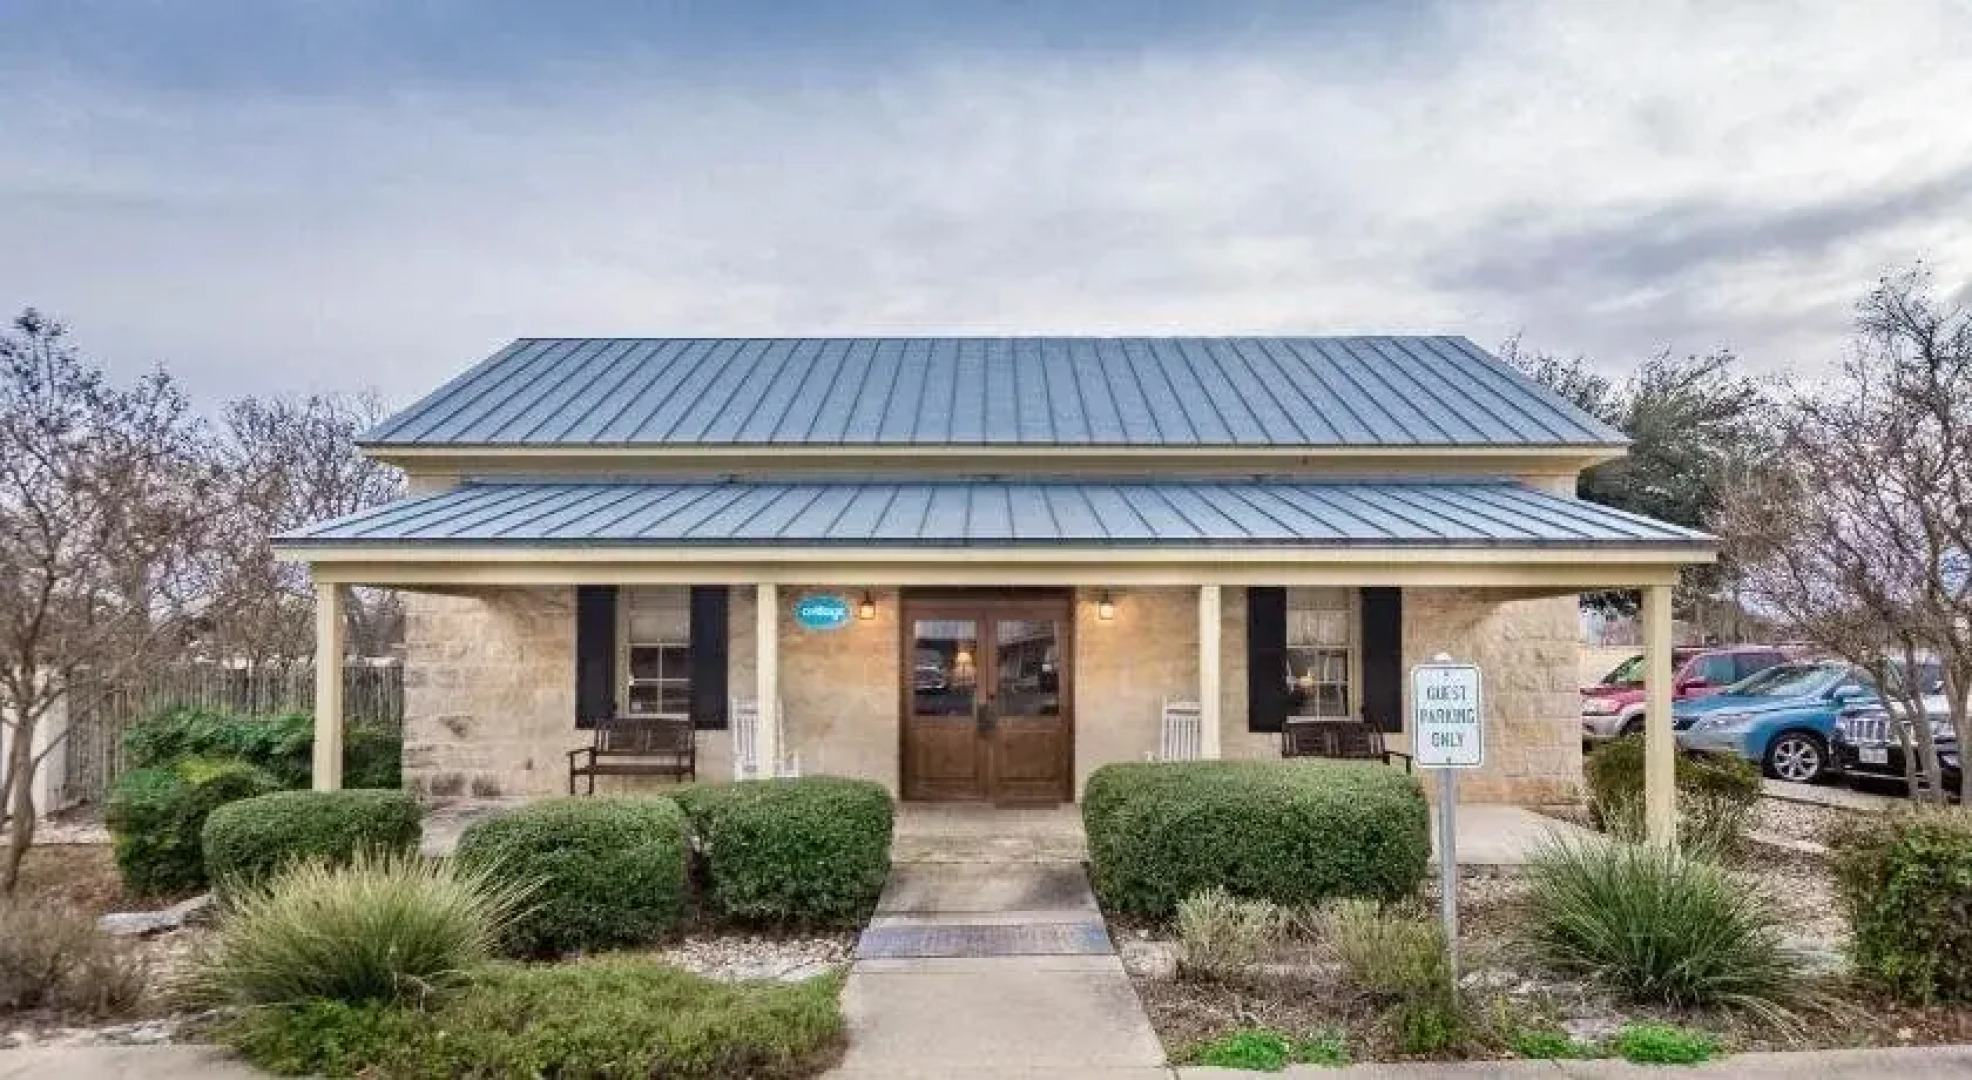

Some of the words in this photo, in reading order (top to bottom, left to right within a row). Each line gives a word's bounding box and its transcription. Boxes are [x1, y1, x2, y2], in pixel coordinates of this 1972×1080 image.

[1427, 685, 1466, 700] GUEST
[1420, 708, 1475, 724] PARKING
[1431, 732, 1464, 747] ONLY
